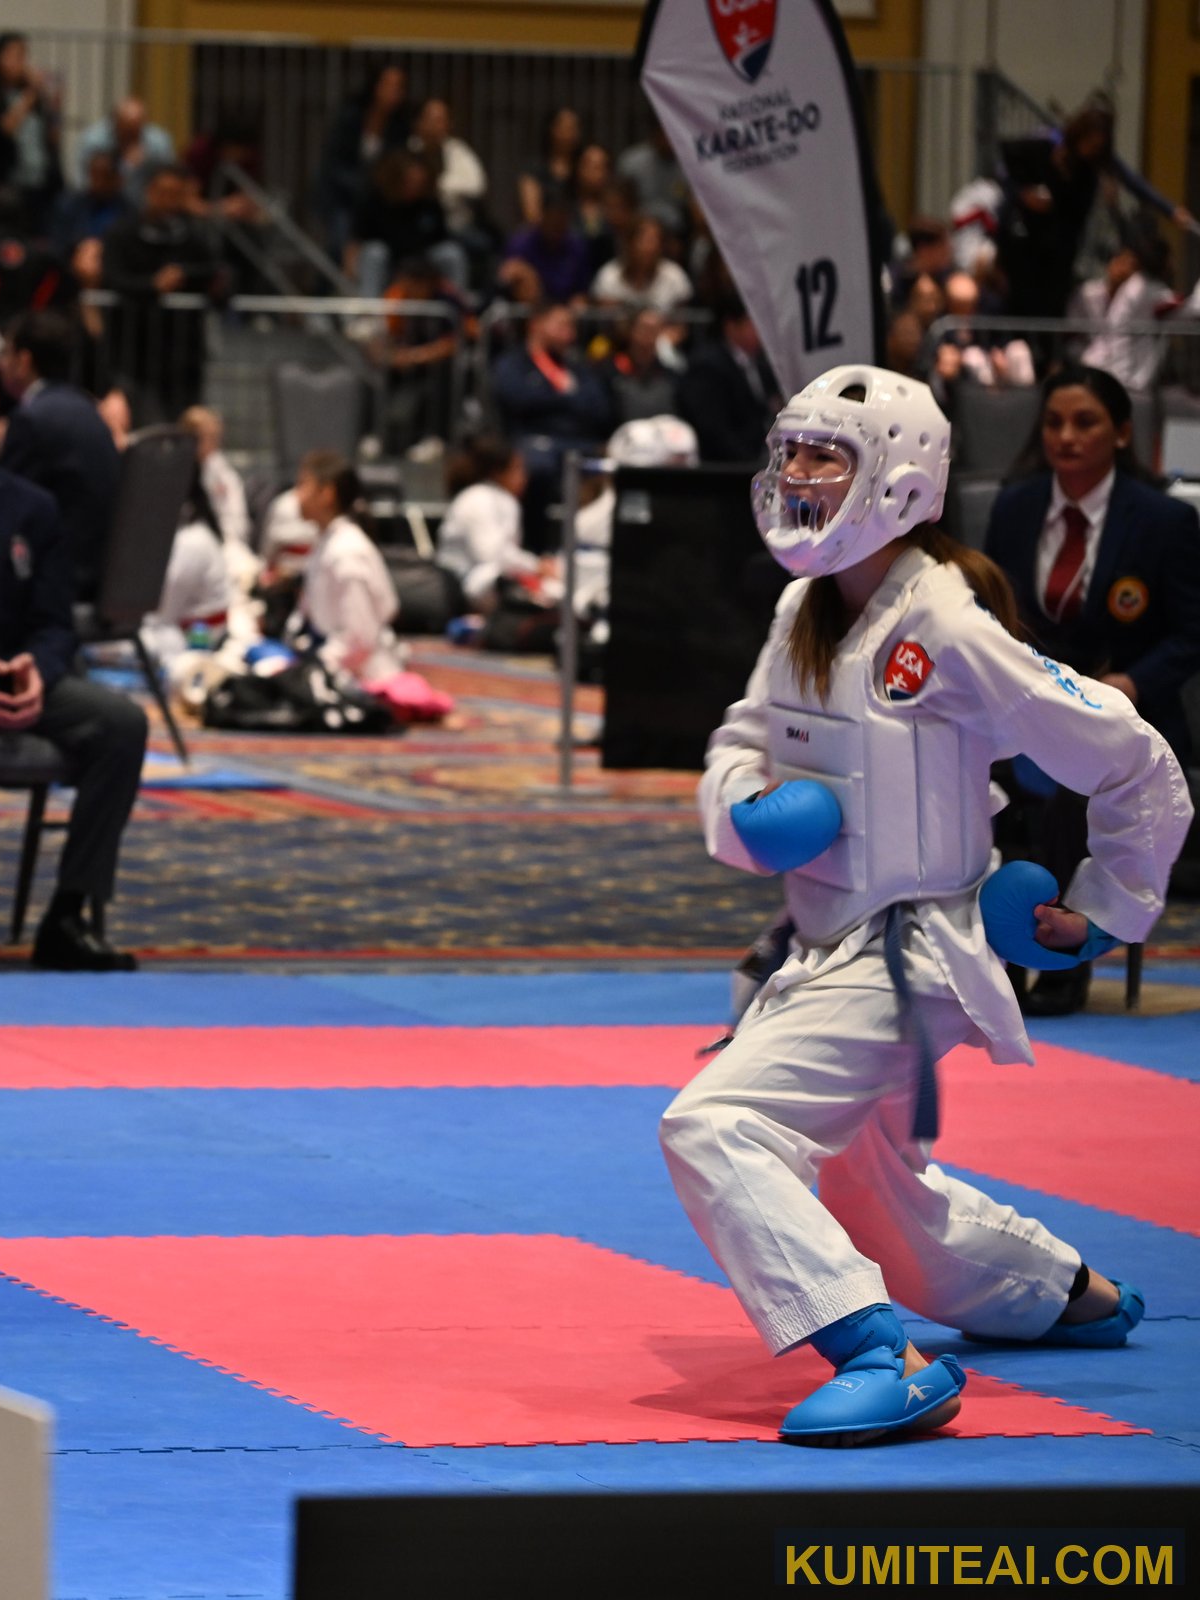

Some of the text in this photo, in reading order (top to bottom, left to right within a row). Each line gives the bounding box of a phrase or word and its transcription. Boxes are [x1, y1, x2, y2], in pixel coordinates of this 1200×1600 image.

[696, 102, 820, 161] KARATE-DO
[795, 257, 843, 353] 12
[895, 644, 923, 680] USA
[786, 727, 810, 743] SMAI
